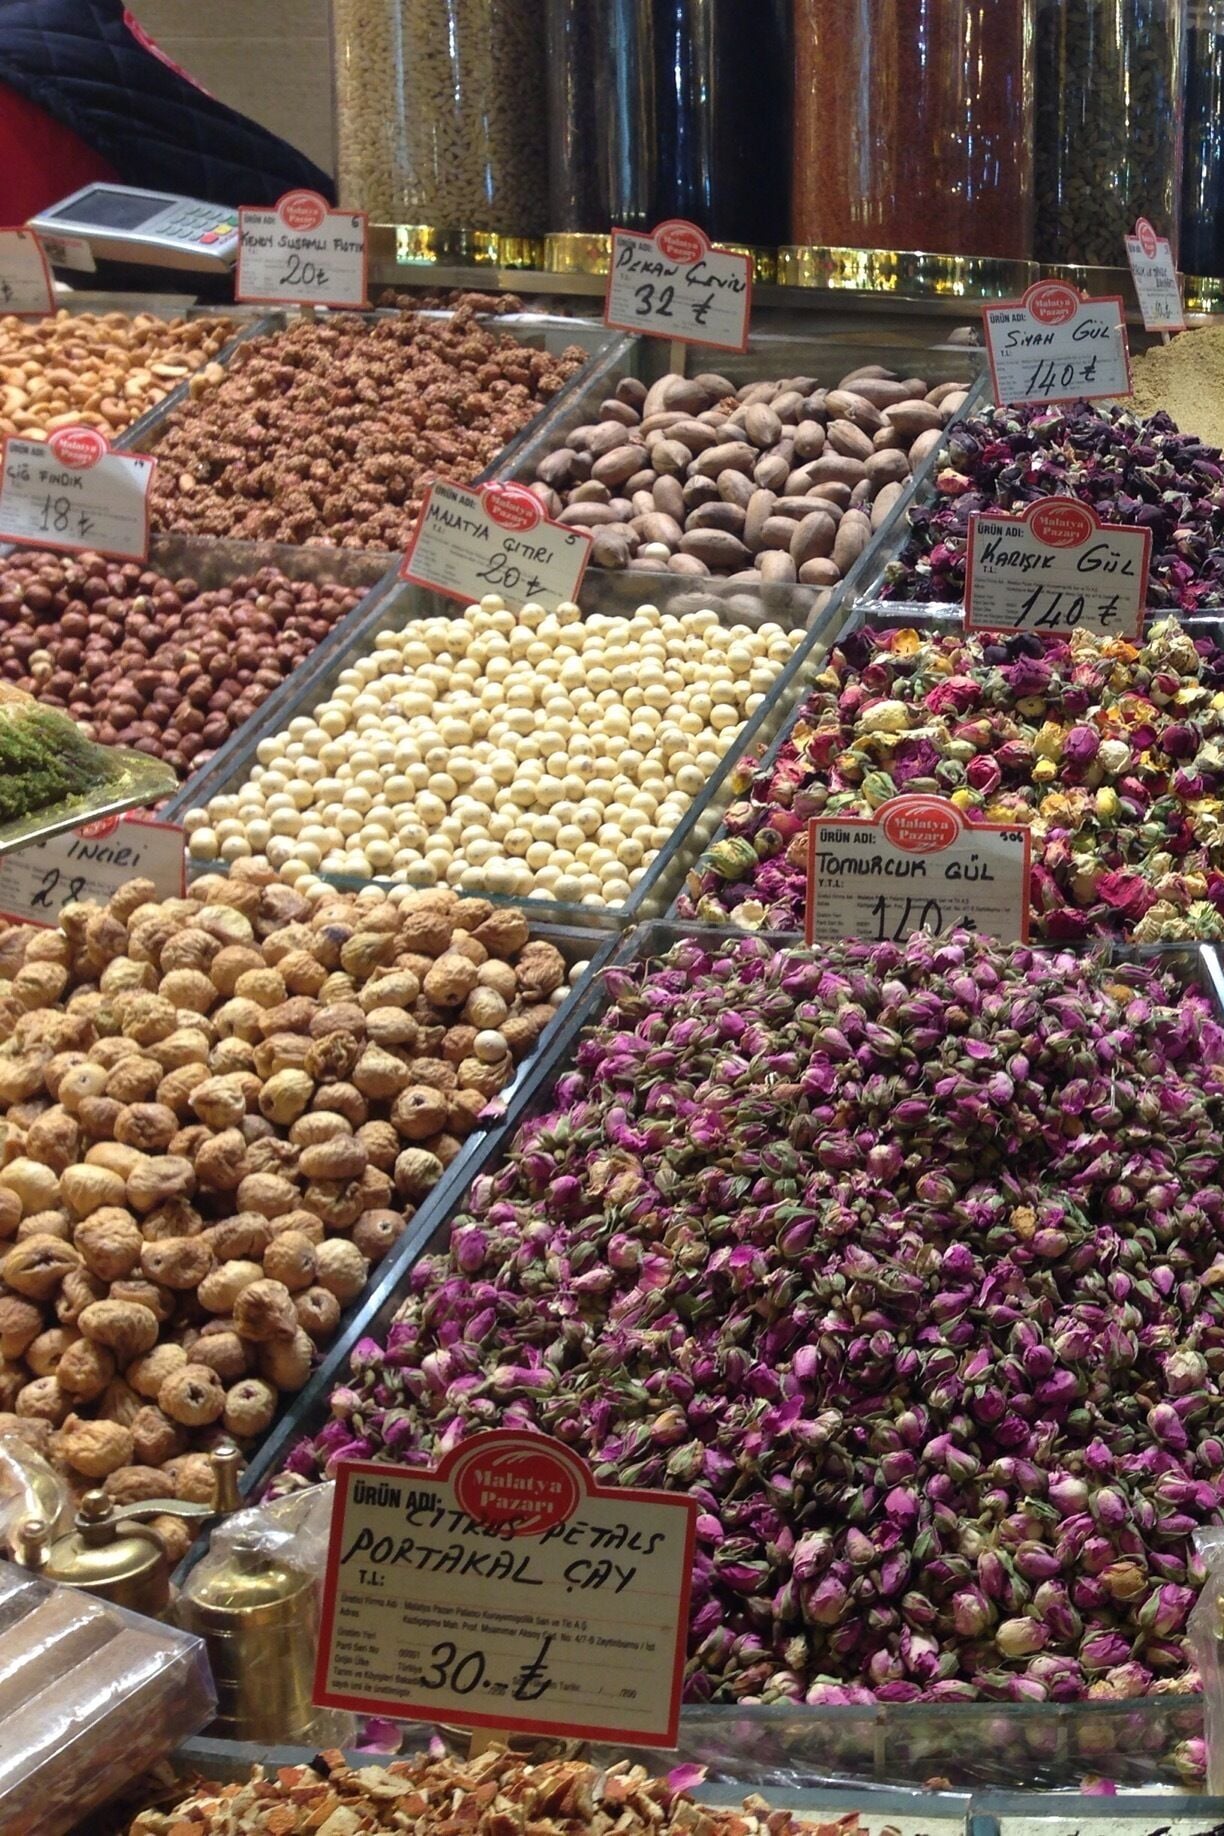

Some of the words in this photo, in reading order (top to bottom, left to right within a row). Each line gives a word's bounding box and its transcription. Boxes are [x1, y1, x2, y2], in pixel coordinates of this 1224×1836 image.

[634, 284, 674, 316] 32
[990, 313, 1010, 324] ÜRÜN
[1072, 319, 1110, 341] GÜL
[1026, 360, 1074, 396] 140
[40, 494, 70, 531] 18
[427, 503, 490, 541] MALATYA
[1040, 516, 1083, 528] Malatya
[564, 534, 581, 545] 5
[978, 523, 1002, 535] ÜRÜN
[1005, 526, 1024, 537] ADI:
[476, 553, 521, 588] 20
[980, 538, 1055, 572] KARIŞIK
[1077, 544, 1134, 576] GÜL
[1014, 585, 1084, 628] 140
[821, 829, 850, 843] ÜRÜN
[854, 831, 876, 844] ADI:
[895, 818, 948, 830] Malatya
[900, 830, 944, 841] Pazarı
[817, 852, 926, 877] TOMURCUK
[945, 854, 994, 881] GÜL
[353, 1480, 401, 1508] ÜRÜN
[473, 1469, 563, 1495] Malatya
[480, 1490, 554, 1513] Pazarı
[539, 1520, 666, 1554] PETALS
[341, 1528, 543, 1585] PORTAKAL
[563, 1559, 637, 1593] ÇAY
